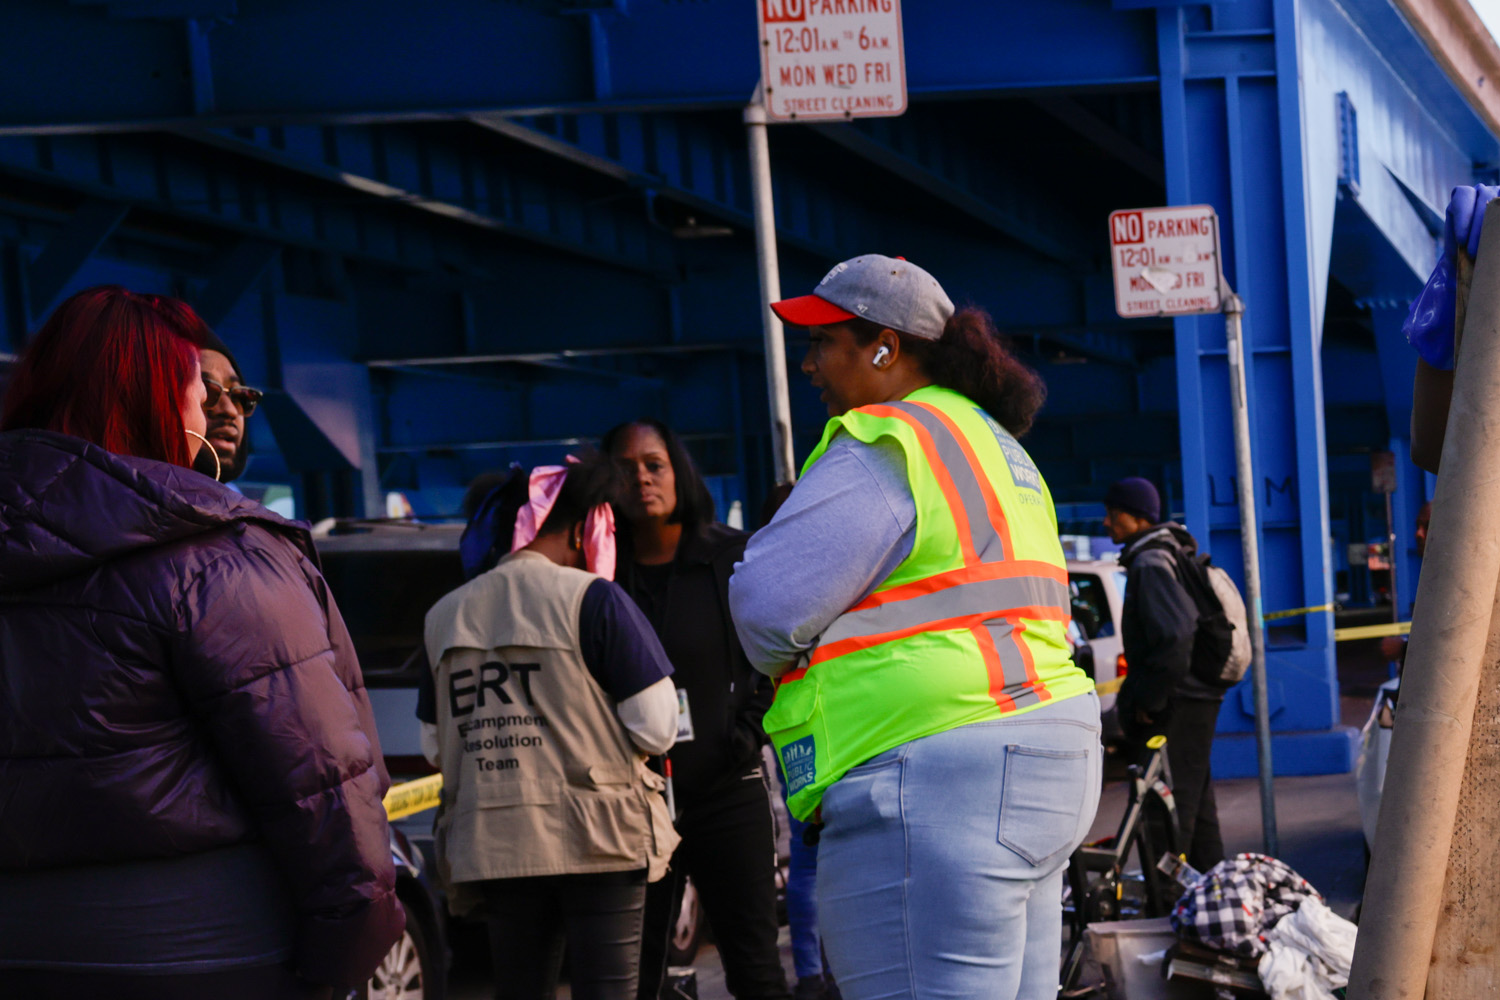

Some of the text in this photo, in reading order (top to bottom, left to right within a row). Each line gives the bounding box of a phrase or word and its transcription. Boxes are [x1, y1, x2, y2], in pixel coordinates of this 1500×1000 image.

[780, 62, 891, 87] MON WED FRI
[784, 95, 894, 112] STREET CLEANING
[1114, 214, 1208, 242] NO PARKING
[1187, 271, 1205, 288] FRI
[1127, 296, 1211, 312] STREET CLEANING
[449, 661, 541, 718] ERT
[476, 758, 519, 771] Team
